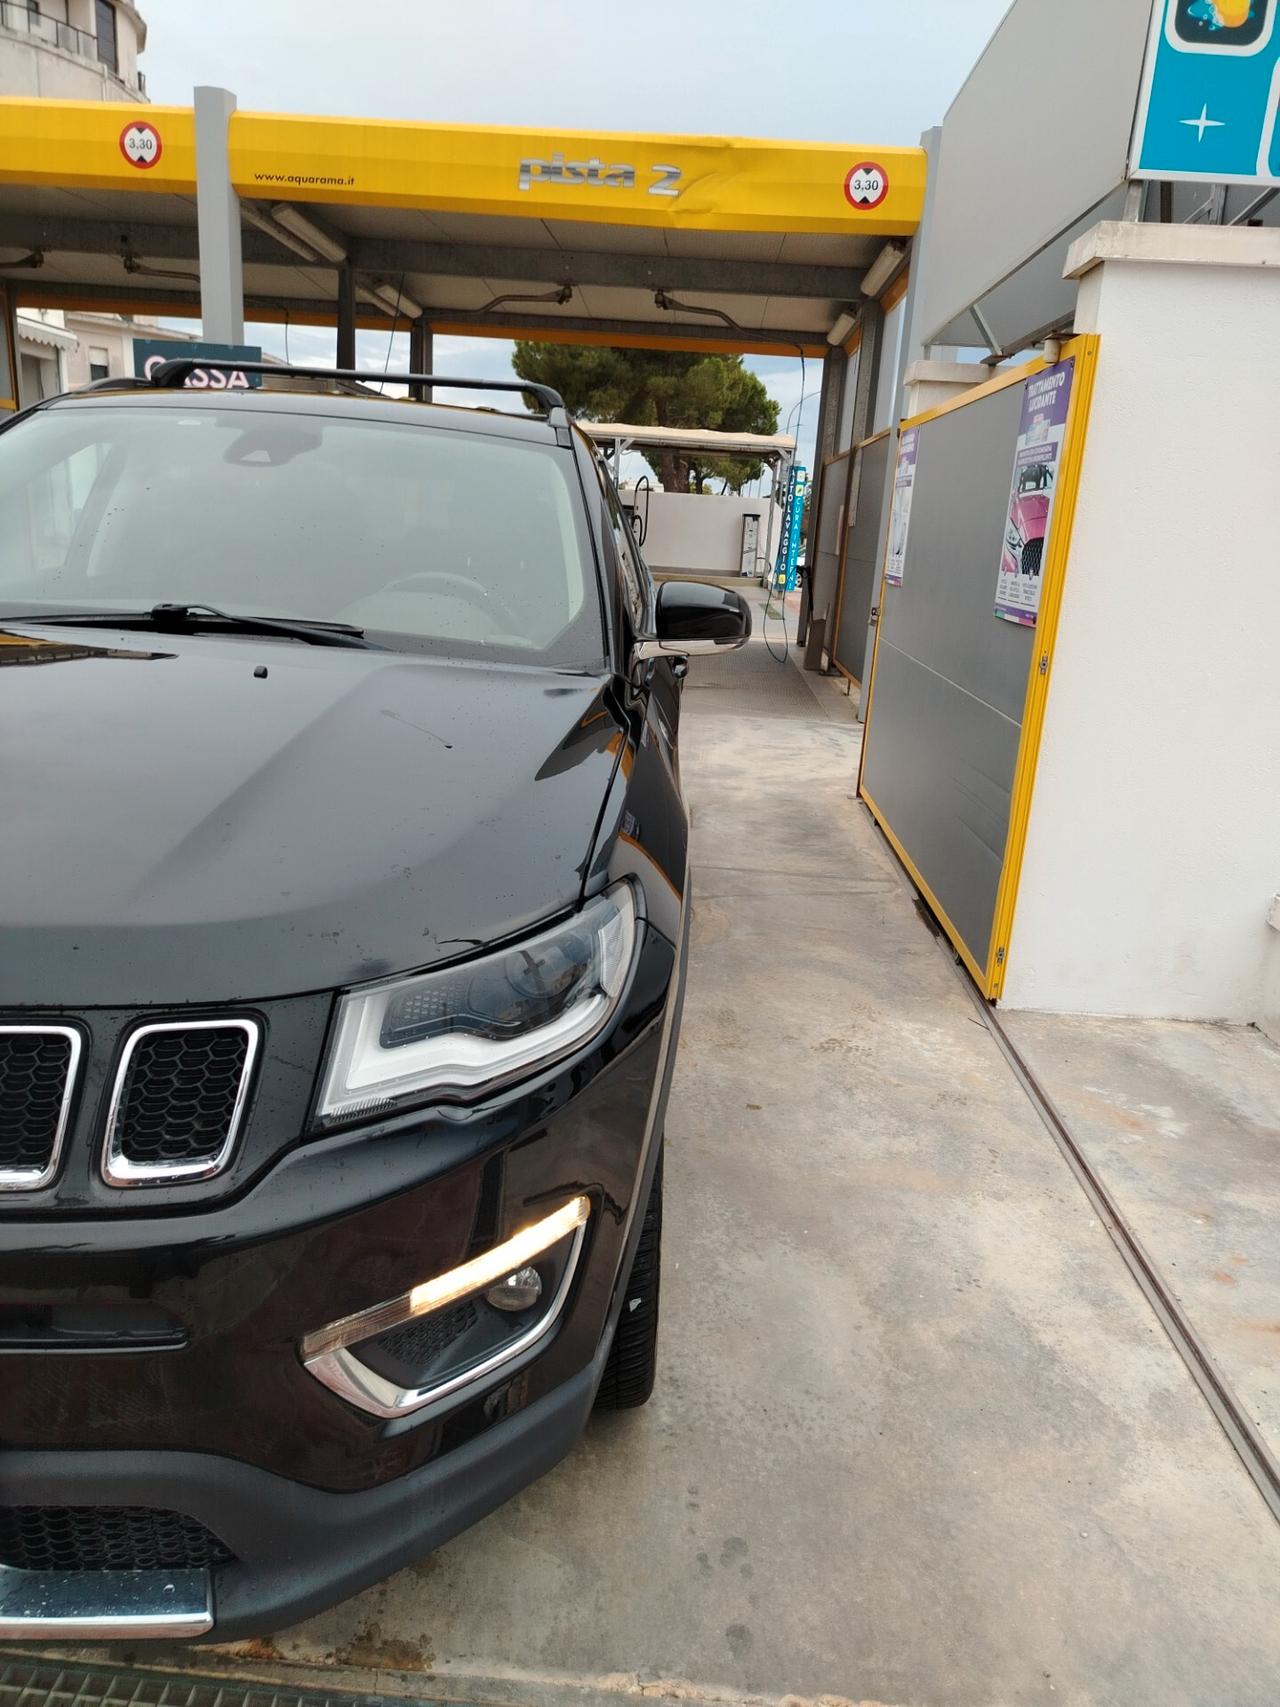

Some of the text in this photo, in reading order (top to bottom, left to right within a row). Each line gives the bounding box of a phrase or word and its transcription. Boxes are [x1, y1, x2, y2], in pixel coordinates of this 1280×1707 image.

[254, 172, 355, 187] www.aquarama.it
[518, 152, 683, 197] pista 2
[144, 355, 250, 389] CSSA
[1028, 371, 1066, 400] TRATTAMENTO
